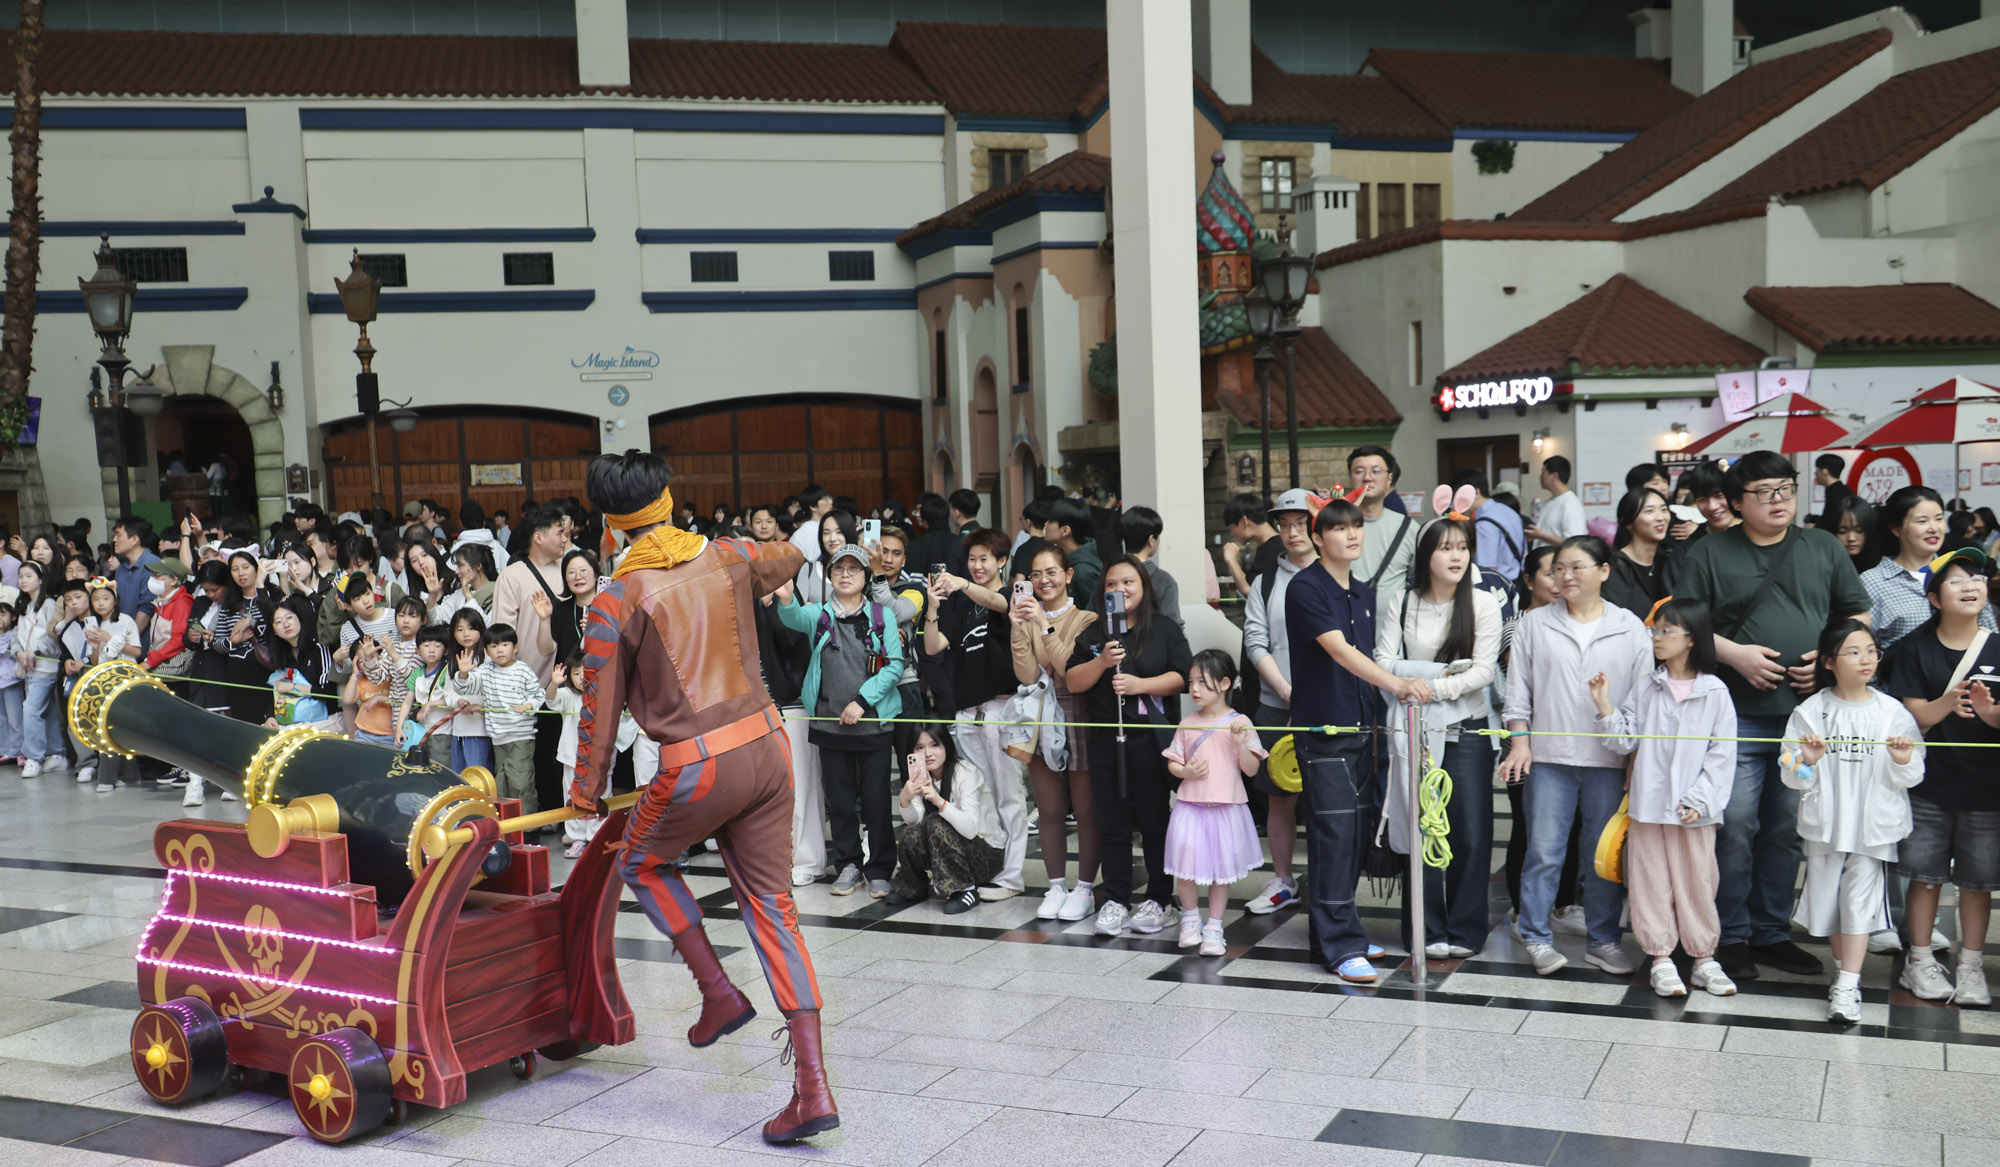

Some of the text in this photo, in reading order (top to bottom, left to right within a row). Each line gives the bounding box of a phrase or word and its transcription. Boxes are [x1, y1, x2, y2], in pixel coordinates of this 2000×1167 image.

[571, 350, 661, 371] Magic Island
[1864, 466, 1903, 479] MADE
[1875, 479, 1893, 490] TO
